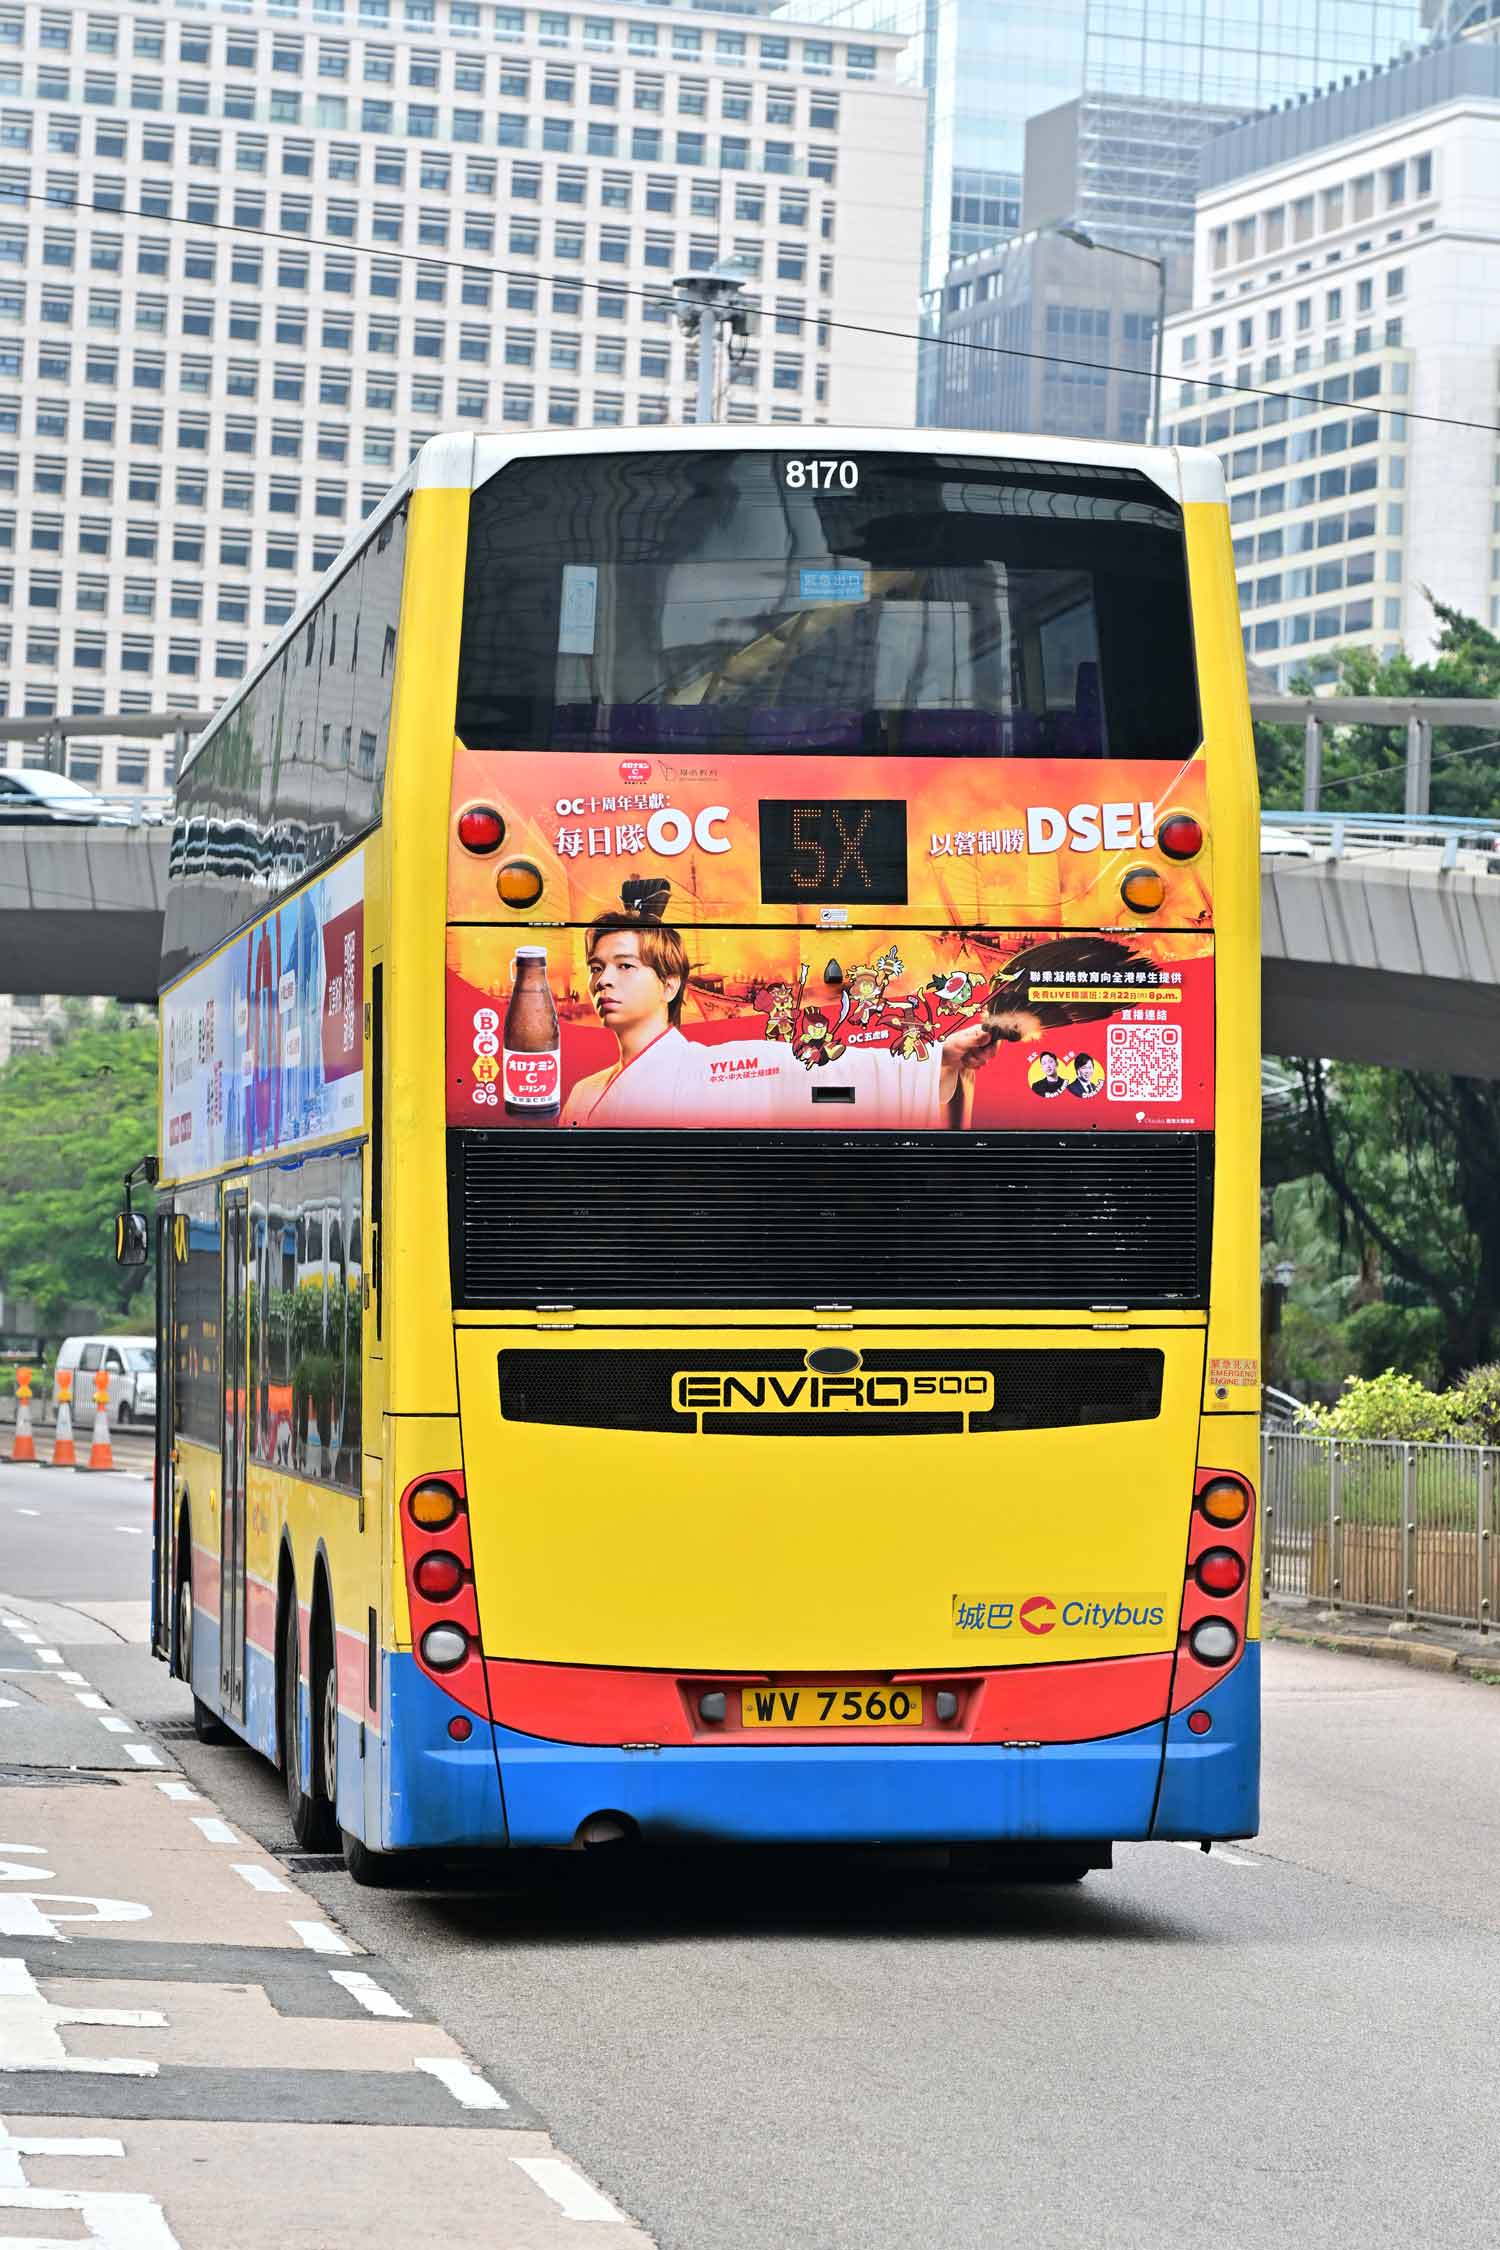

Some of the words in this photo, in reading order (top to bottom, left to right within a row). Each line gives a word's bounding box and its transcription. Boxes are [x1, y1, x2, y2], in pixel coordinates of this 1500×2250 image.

[786, 460, 859, 489] 8170
[790, 808, 872, 888] 5X
[1121, 1009, 1167, 1021] 直播連結
[480, 1016, 493, 1030] B
[478, 1040, 494, 1054] C
[479, 1065, 493, 1079] H
[509, 1060, 556, 1072] オロナミン
[525, 1072, 538, 1083] C
[475, 1091, 485, 1099] C
[519, 1084, 547, 1093] ドリンク
[678, 1376, 908, 1408] ENVIRO
[913, 1376, 988, 1395] 500
[955, 1602, 1014, 1630] 城巴
[1062, 1601, 1164, 1629] Citybus
[755, 1692, 800, 1722] WV
[816, 1691, 911, 1721] 7560
